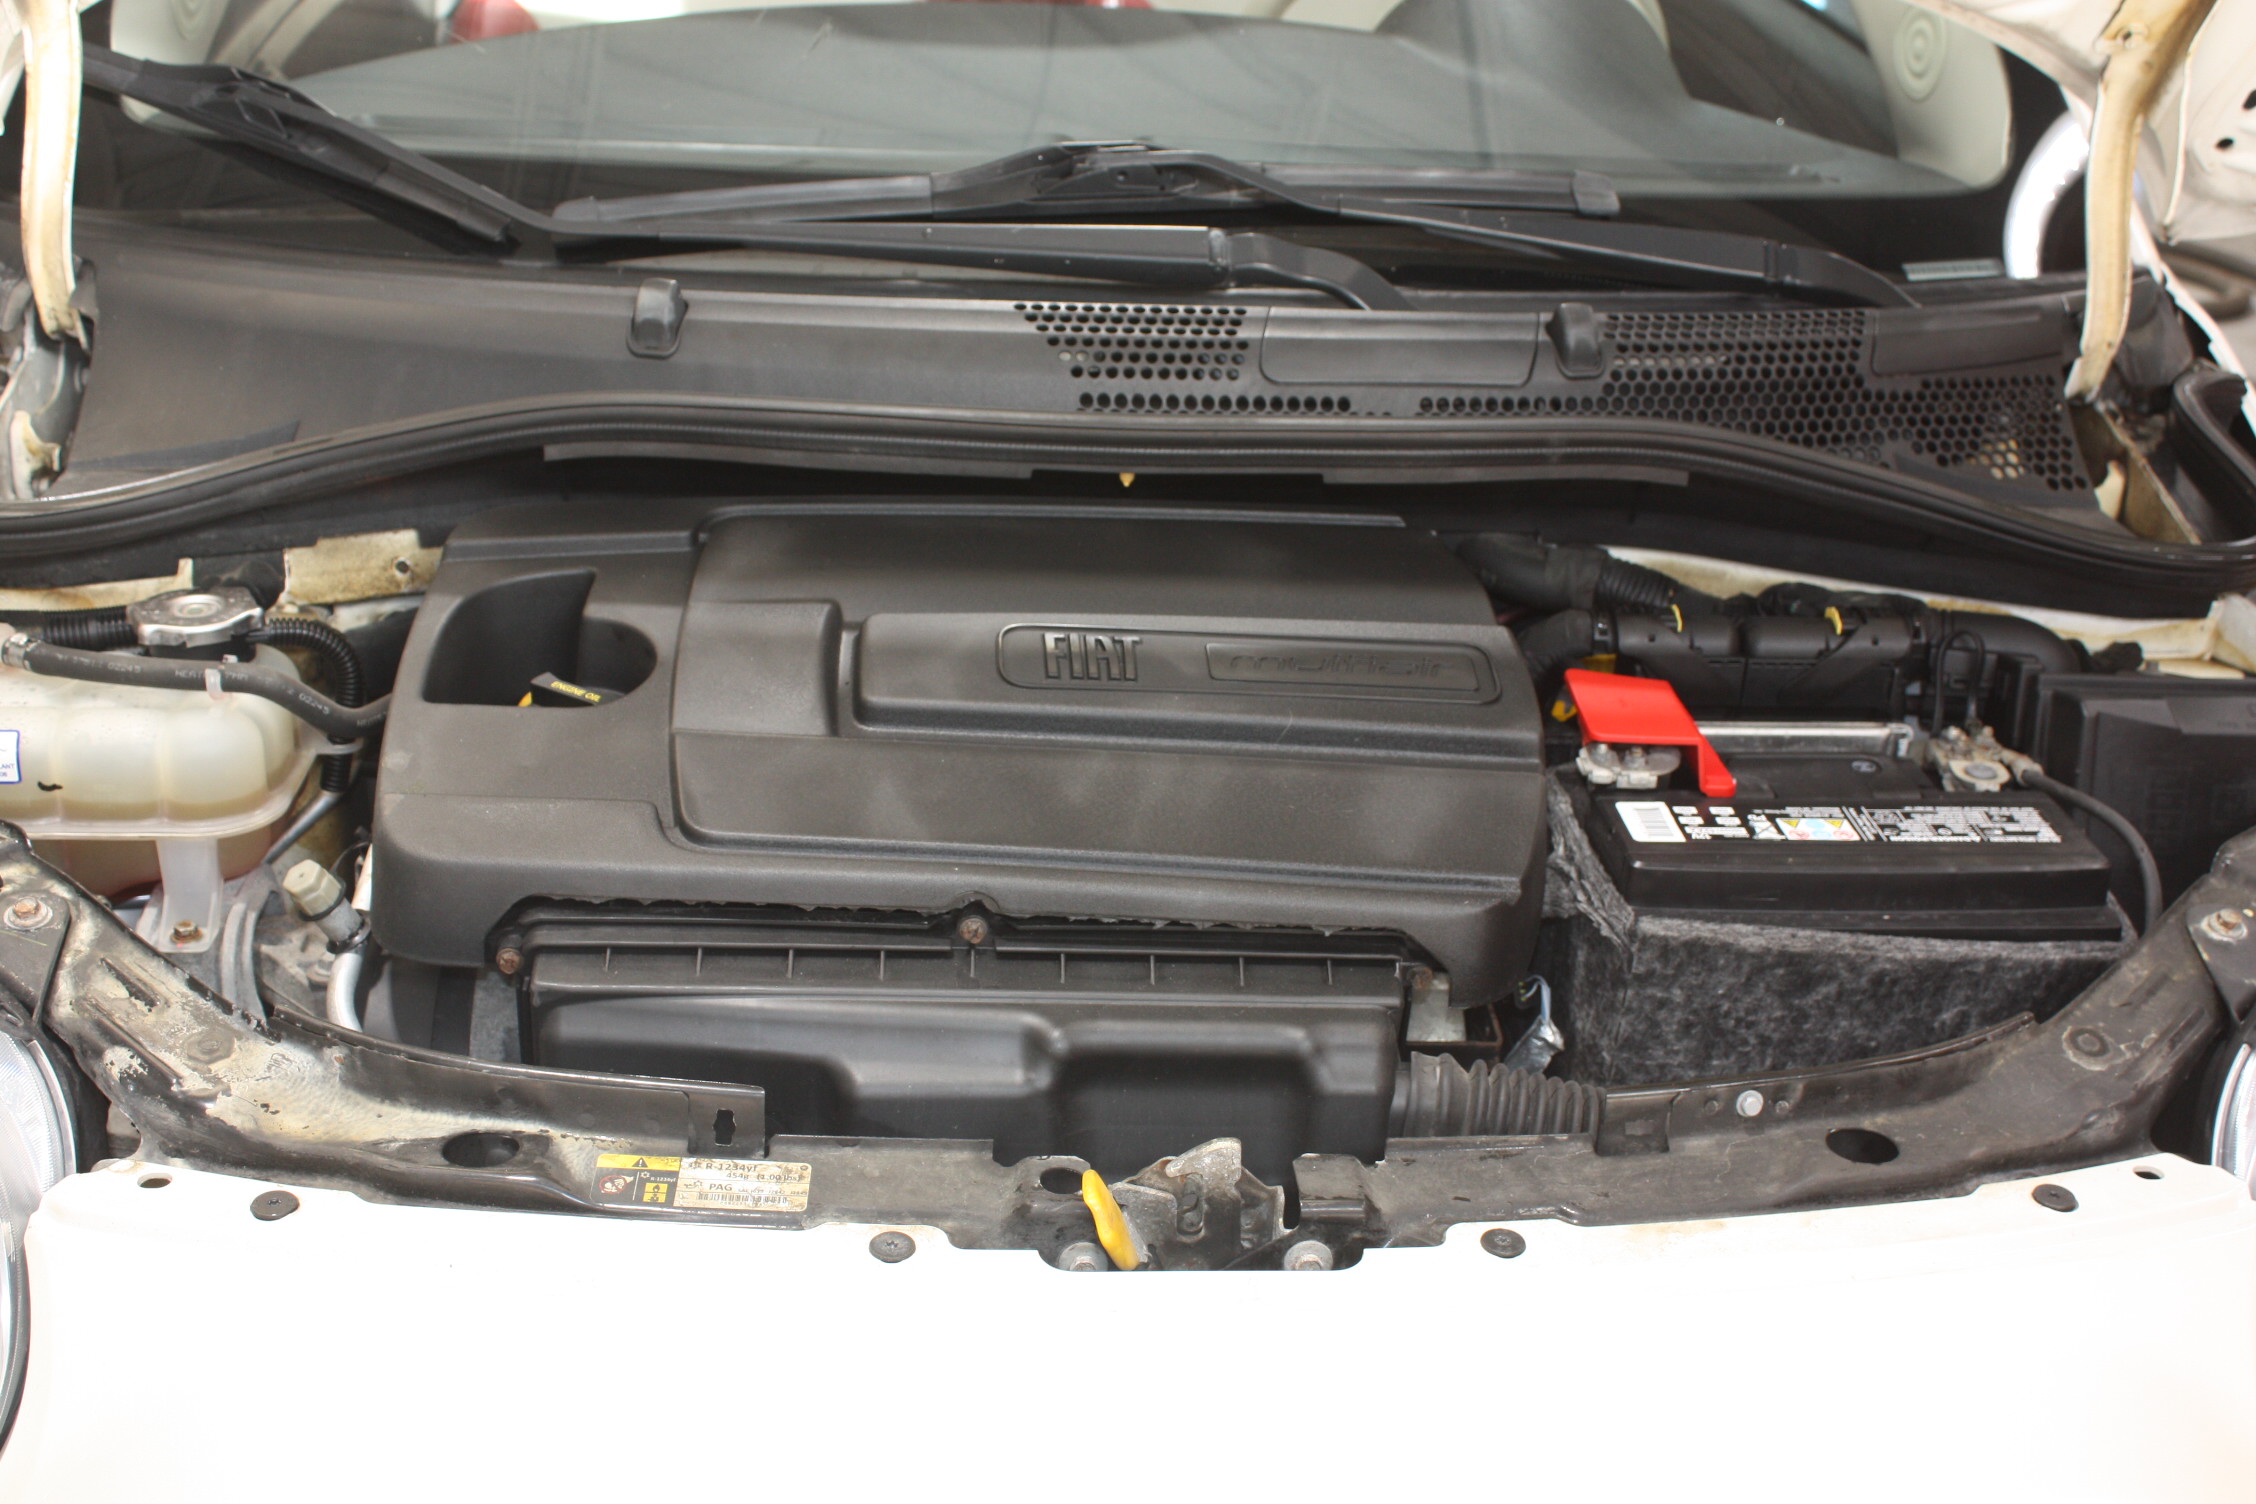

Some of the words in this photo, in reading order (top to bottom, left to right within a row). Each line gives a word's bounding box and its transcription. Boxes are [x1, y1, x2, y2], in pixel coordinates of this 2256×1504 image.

[1041, 632, 1144, 682] FIAT
[551, 681, 587, 696] ENGINE
[705, 1163, 758, 1172] R-1234yf
[709, 1183, 733, 1192] PAG
